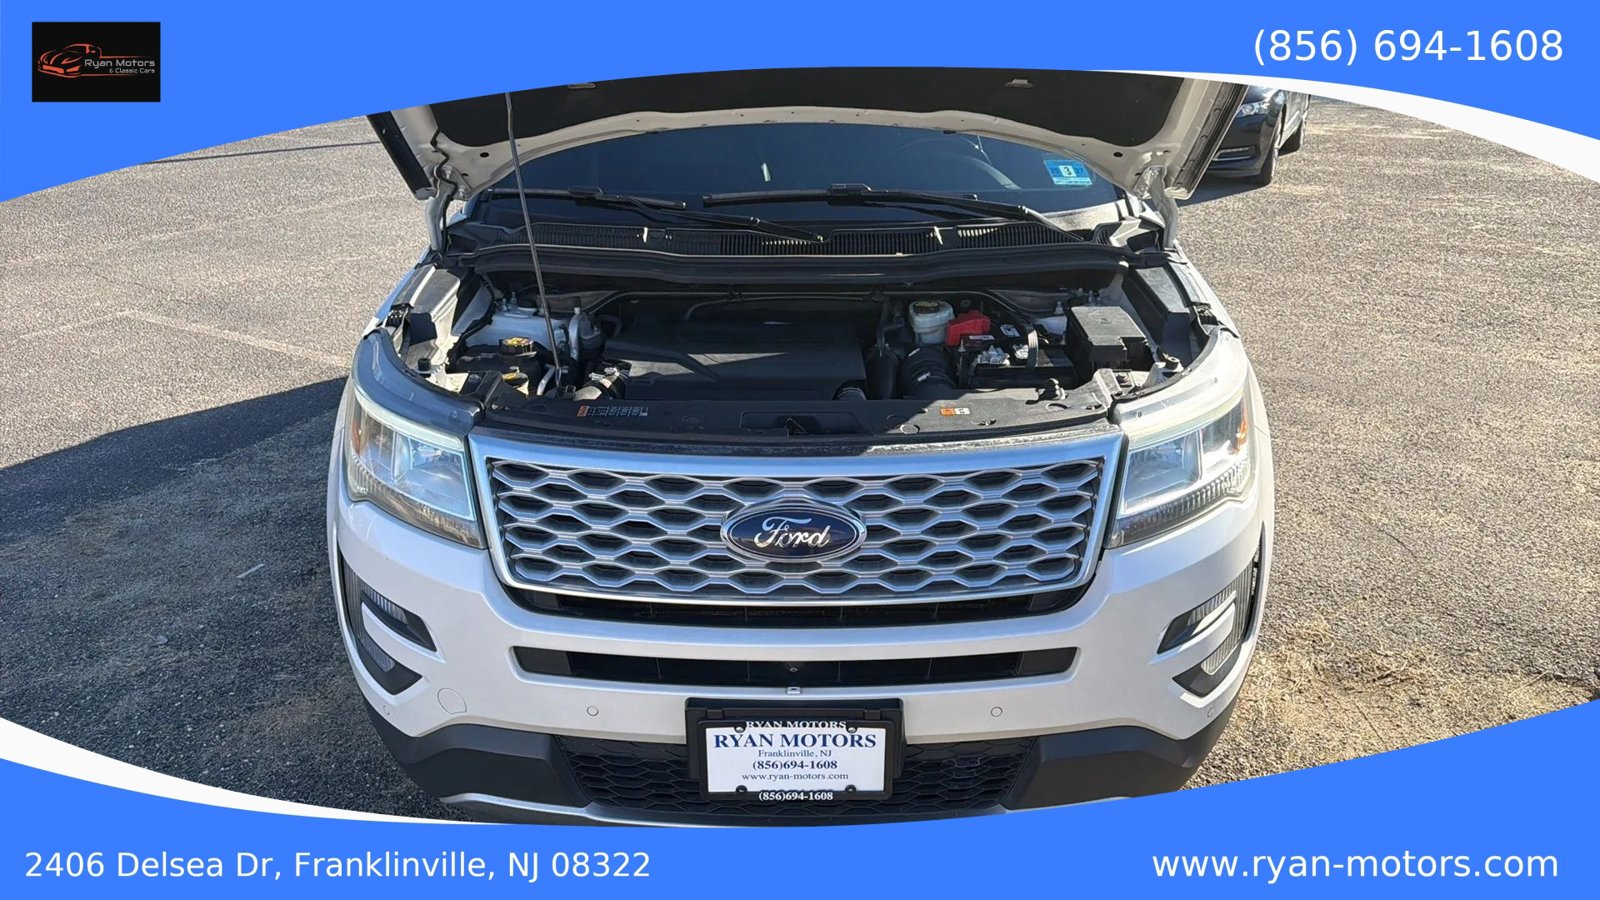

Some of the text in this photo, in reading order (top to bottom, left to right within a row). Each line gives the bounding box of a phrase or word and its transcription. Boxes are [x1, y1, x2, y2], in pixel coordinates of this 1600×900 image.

[1063, 166, 1072, 176] 3
[753, 516, 831, 549] Ford
[746, 720, 847, 729] RYAN MOTORS
[713, 733, 877, 748] RYAN MOTORS
[758, 749, 832, 758] Franklinville, NJ
[752, 760, 838, 770] (856)694-1608
[741, 772, 849, 781] www.ryan-motors.com
[758, 791, 834, 801] (856)694-1608
